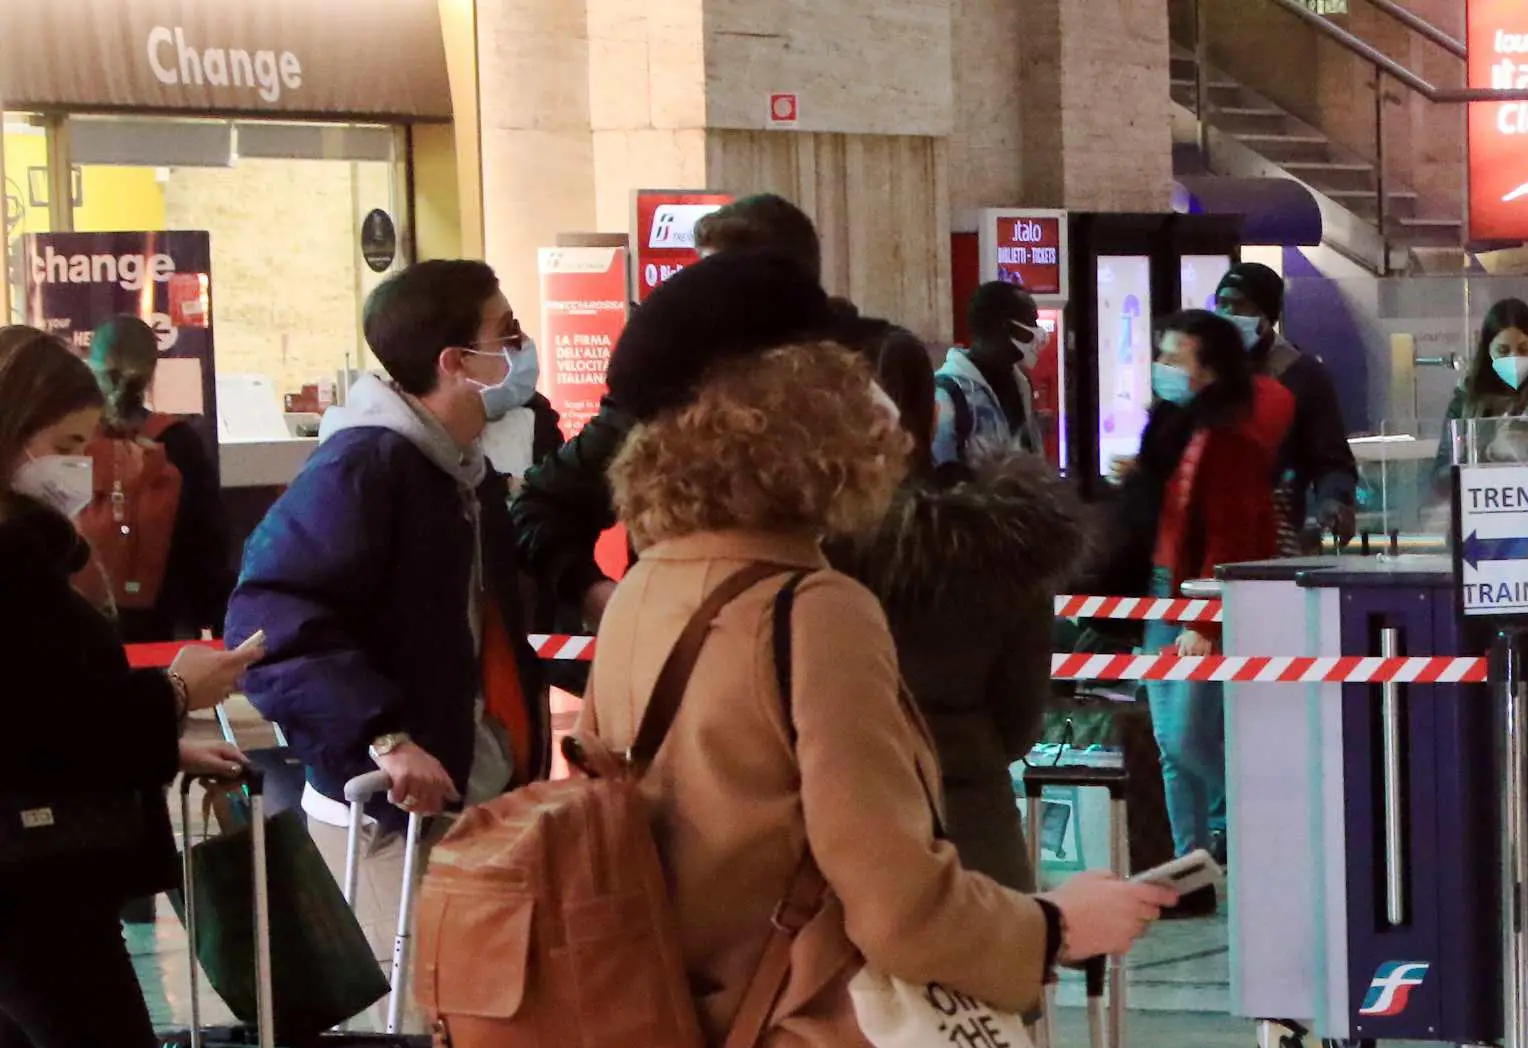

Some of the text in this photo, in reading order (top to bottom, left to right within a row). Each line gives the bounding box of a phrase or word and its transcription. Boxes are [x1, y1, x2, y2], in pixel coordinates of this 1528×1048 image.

[147, 26, 302, 102] Change
[998, 246, 1027, 264] BIGLIETTI
[1032, 246, 1057, 264] TICKETS
[31, 246, 176, 290] change
[555, 334, 611, 346] LA FIRMA
[556, 346, 611, 359] DELL'ALTA
